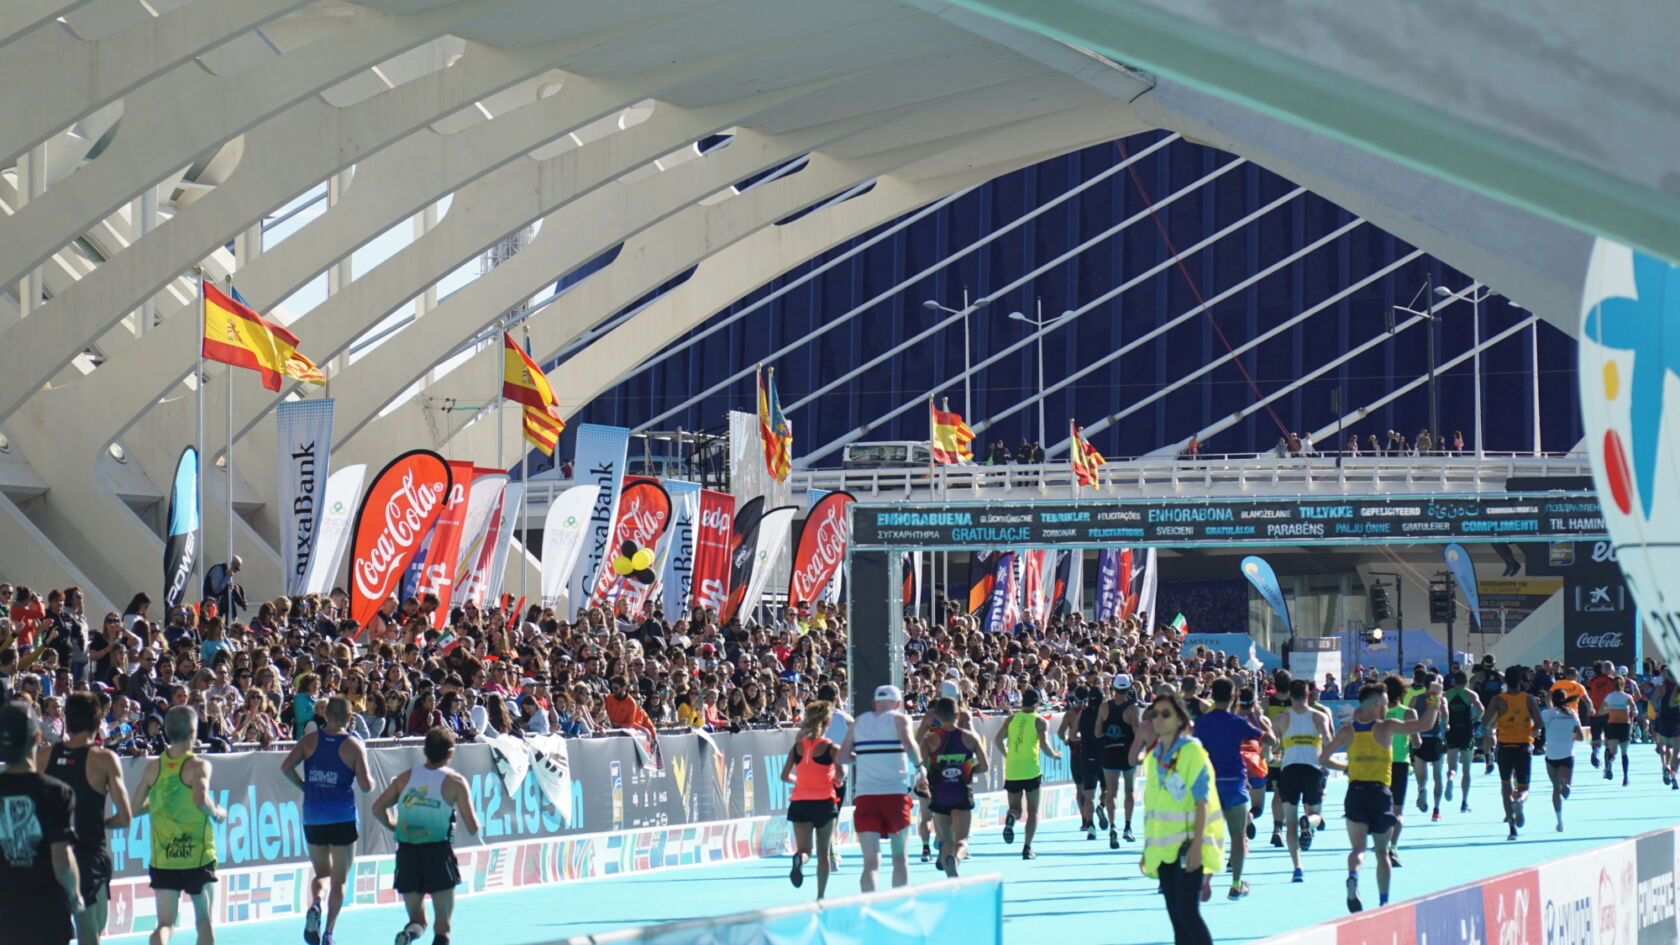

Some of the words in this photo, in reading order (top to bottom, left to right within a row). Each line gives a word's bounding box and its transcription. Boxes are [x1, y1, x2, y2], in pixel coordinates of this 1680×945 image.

[290, 440, 316, 576] aixaBank
[1148, 508, 1234, 522] ENHORABONA
[1299, 506, 1354, 519] TILLYKKE
[702, 507, 731, 535] edp
[876, 512, 973, 526] ENHORABUENA
[1461, 519, 1539, 532] COMPLIMENTI
[1550, 518, 1566, 530] TIL
[951, 526, 1030, 541] GRATULACJE
[1267, 521, 1324, 536] PARABÉNS
[1335, 523, 1364, 533] PALJU
[673, 515, 693, 617] aixaBank
